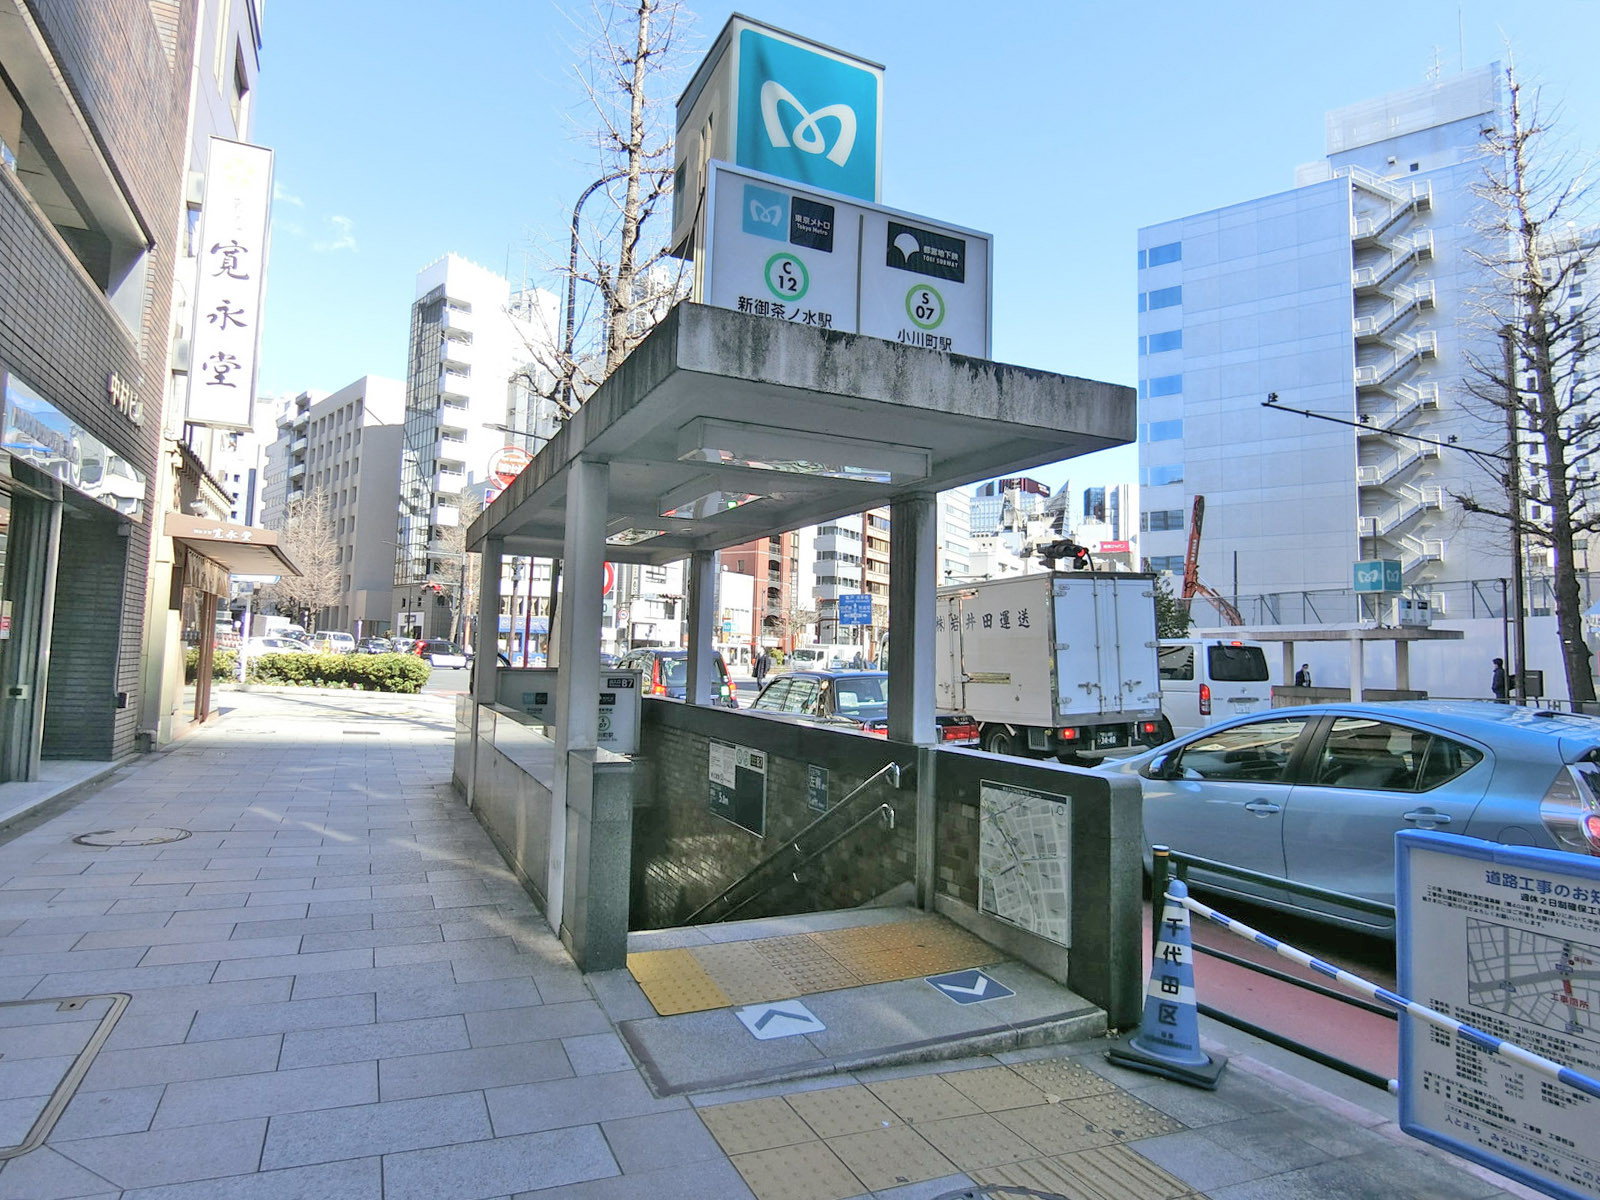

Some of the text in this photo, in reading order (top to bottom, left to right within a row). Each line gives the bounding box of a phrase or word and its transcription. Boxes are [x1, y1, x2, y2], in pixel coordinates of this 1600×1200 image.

[795, 214, 831, 230] 東京メトロ
[782, 261, 792, 274] C
[778, 275, 798, 292] 12
[921, 292, 930, 305] S
[202, 240, 250, 388] 寛永堂
[737, 295, 833, 329] 新御茶ノ水駅
[915, 305, 935, 320] 07
[897, 328, 953, 352] 小川町駅
[1158, 917, 1184, 1027] 千代田区
